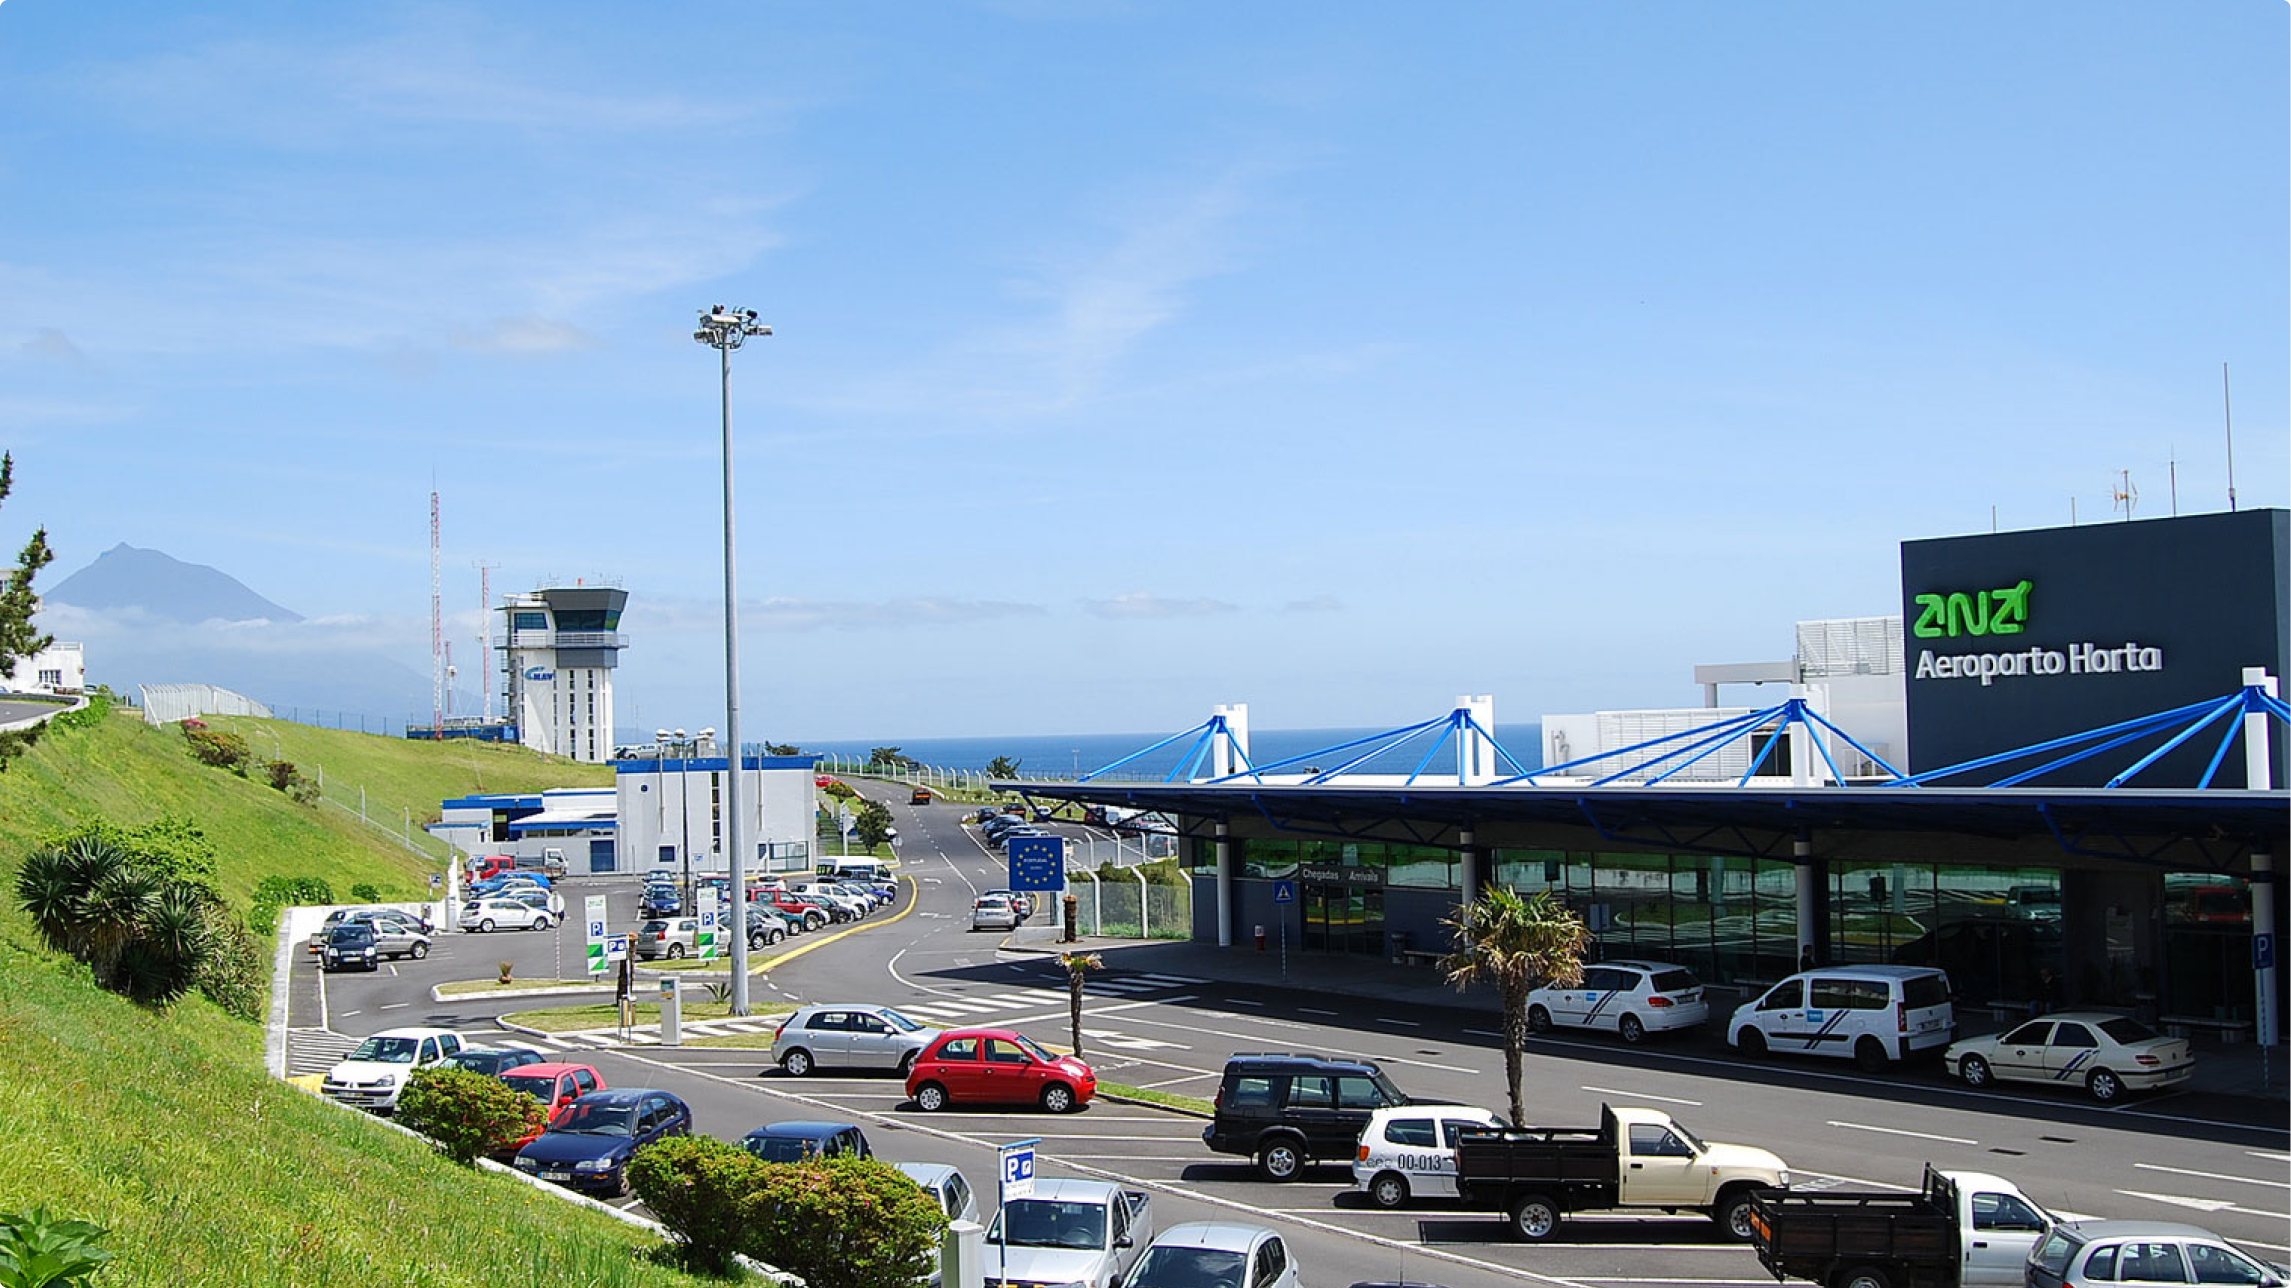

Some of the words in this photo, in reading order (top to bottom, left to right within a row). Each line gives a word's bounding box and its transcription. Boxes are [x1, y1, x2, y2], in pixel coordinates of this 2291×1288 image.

[1915, 647, 2066, 686] Aeroporto
[2069, 643, 2163, 674] Horta
[2258, 936, 2269, 960] P
[1007, 1157, 1019, 1182] P
[1398, 1154, 1441, 1171] 00-013
